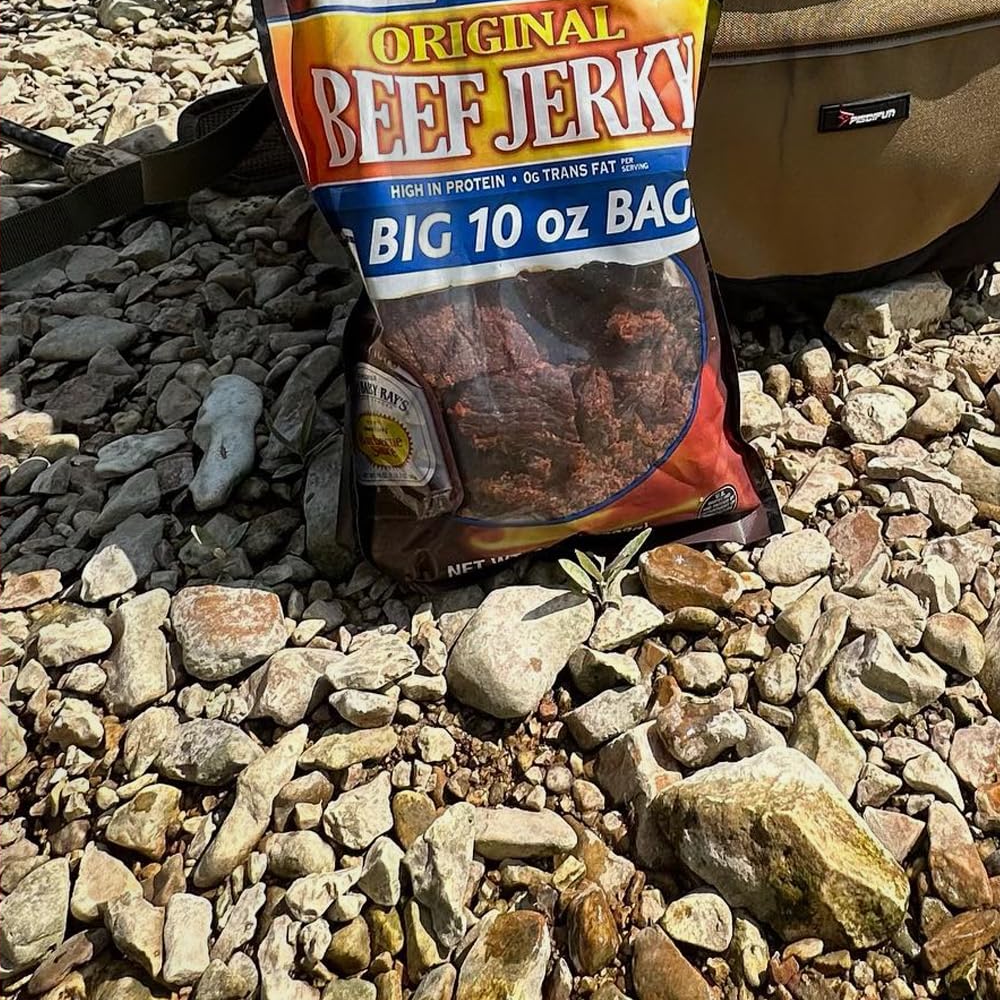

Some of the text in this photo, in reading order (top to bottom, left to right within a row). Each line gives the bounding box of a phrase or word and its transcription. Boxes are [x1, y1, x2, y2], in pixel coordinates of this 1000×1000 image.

[370, 6, 625, 65] ORIGINAL
[311, 35, 694, 167] BEEF JERKY
[390, 183, 424, 199] HIGH
[427, 181, 442, 196] IN
[446, 174, 505, 194] PROTEIN
[544, 164, 588, 181] TRANS
[592, 160, 616, 175] FAT
[620, 157, 634, 165] PER
[621, 162, 649, 172] SERVING
[369, 180, 691, 265] BIG 10 oz BAG
